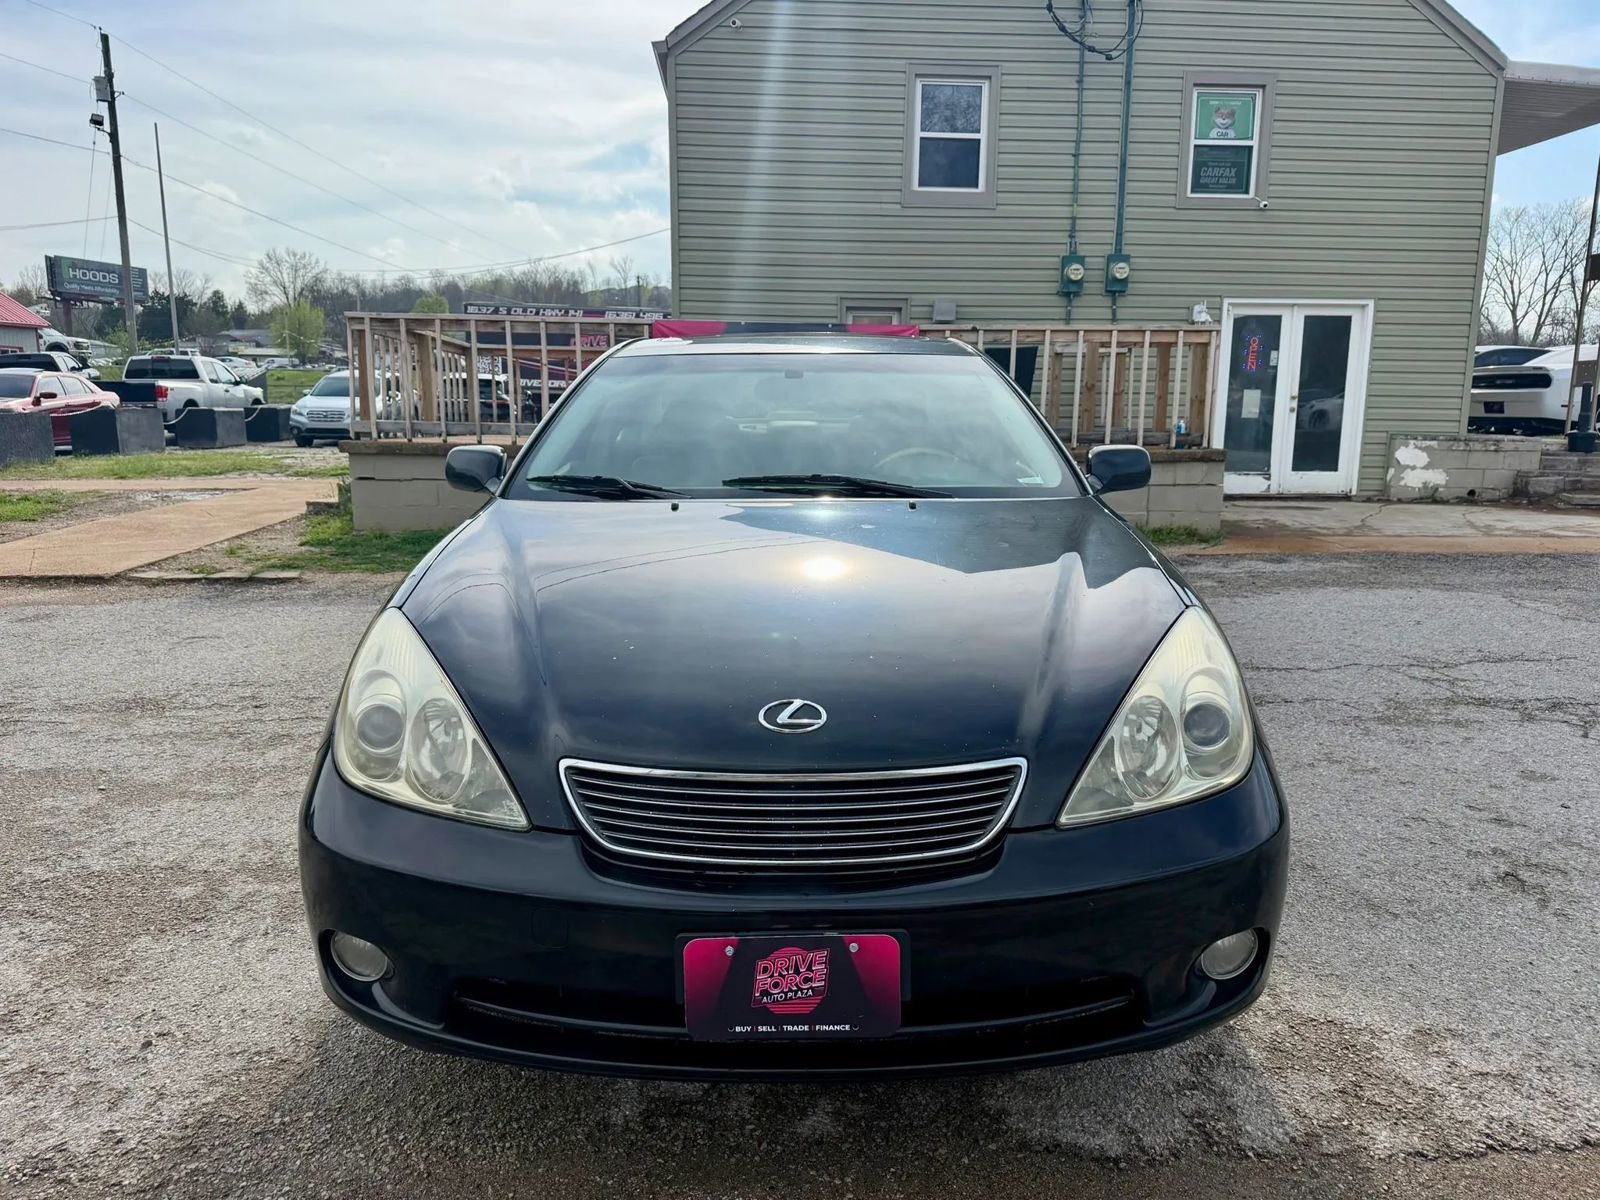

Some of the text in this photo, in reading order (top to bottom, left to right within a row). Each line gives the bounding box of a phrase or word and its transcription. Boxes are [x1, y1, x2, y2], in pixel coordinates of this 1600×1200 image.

[1200, 166, 1237, 177] CARFAX
[68, 267, 119, 284] HOODS
[467, 305, 495, 314] 1637
[498, 306, 508, 315] S
[511, 307, 536, 316] OLD
[539, 308, 565, 317] HWY
[1247, 336, 1259, 372] OPEN
[757, 950, 828, 979] DRIVE
[755, 968, 827, 996] FORCE
[761, 989, 813, 1004] AUTO PLAZA
